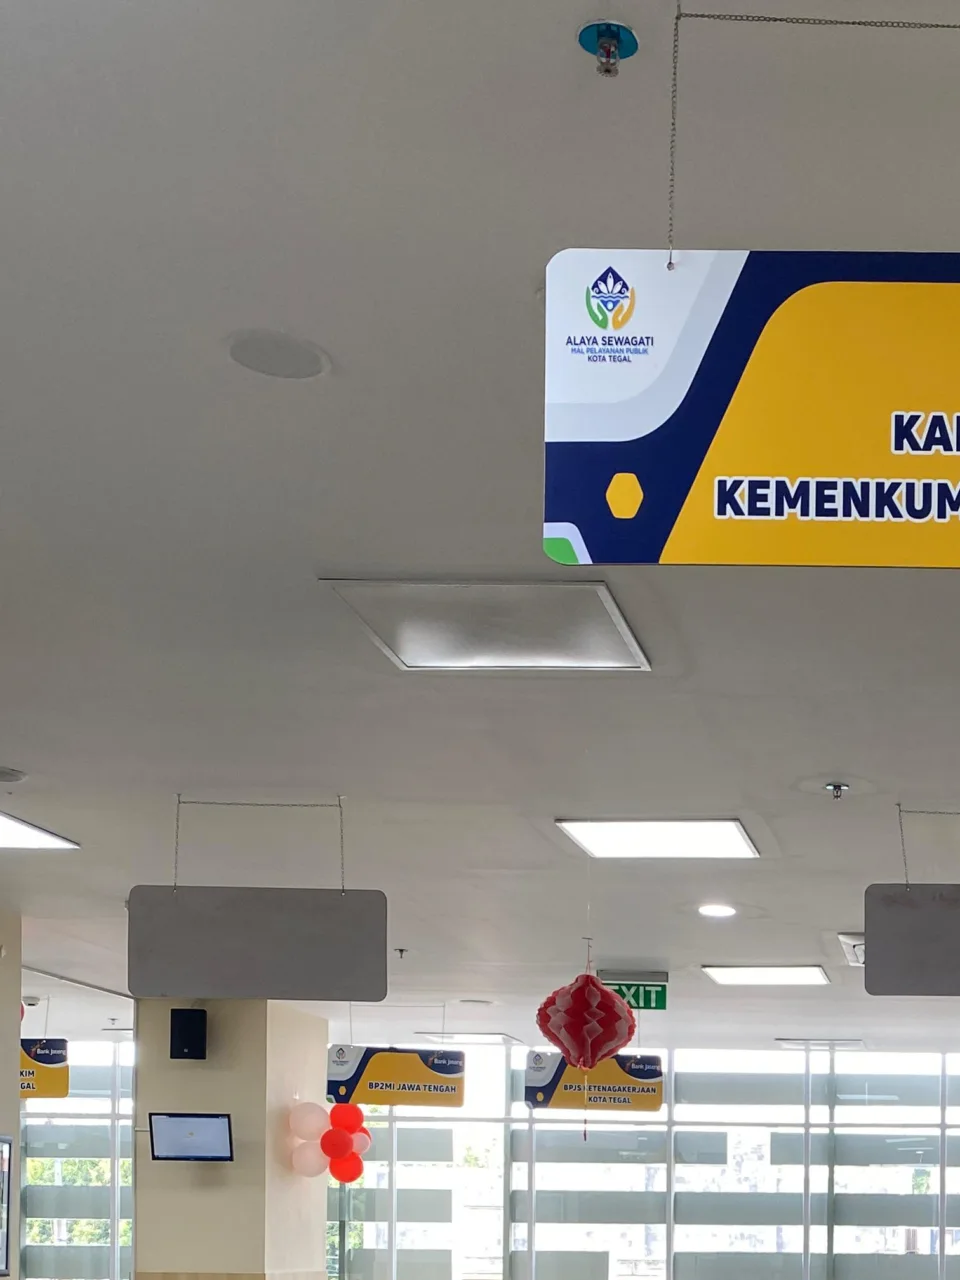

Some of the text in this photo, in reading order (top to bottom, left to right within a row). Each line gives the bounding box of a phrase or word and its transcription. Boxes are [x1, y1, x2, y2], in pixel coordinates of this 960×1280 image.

[566, 336, 654, 346] ALAYA SEWAGATI
[604, 985, 662, 1008] XIT
[368, 1081, 457, 1093] BP2MI JAWA TENGAH
[609, 1096, 632, 1104] TEGAL
